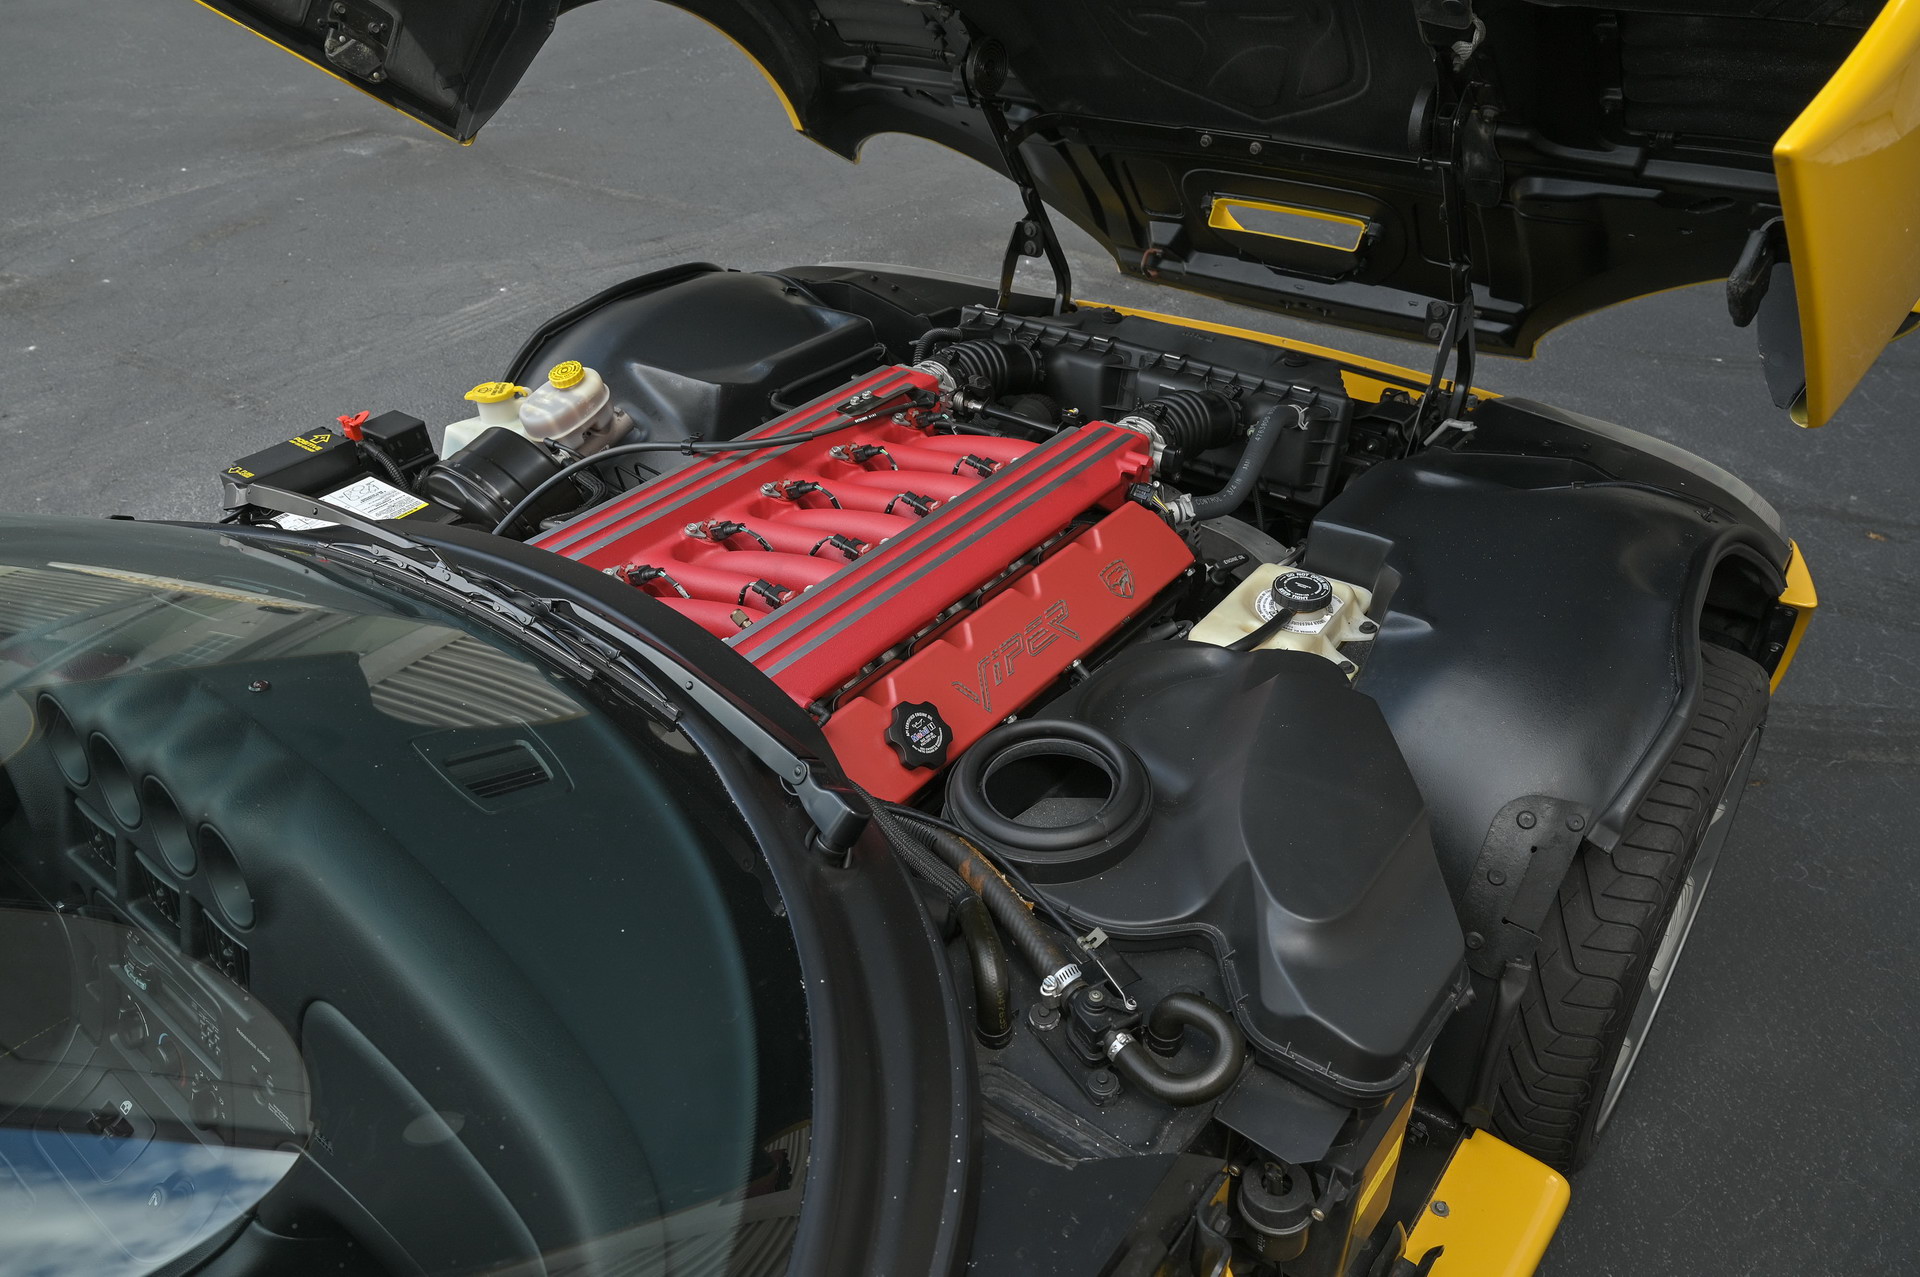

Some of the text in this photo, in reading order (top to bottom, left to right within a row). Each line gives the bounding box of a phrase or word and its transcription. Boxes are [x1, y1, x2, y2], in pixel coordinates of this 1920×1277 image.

[1223, 556, 1239, 564] ENGINE
[951, 599, 1081, 713] VIPER
[910, 726, 930, 742] Mobil
